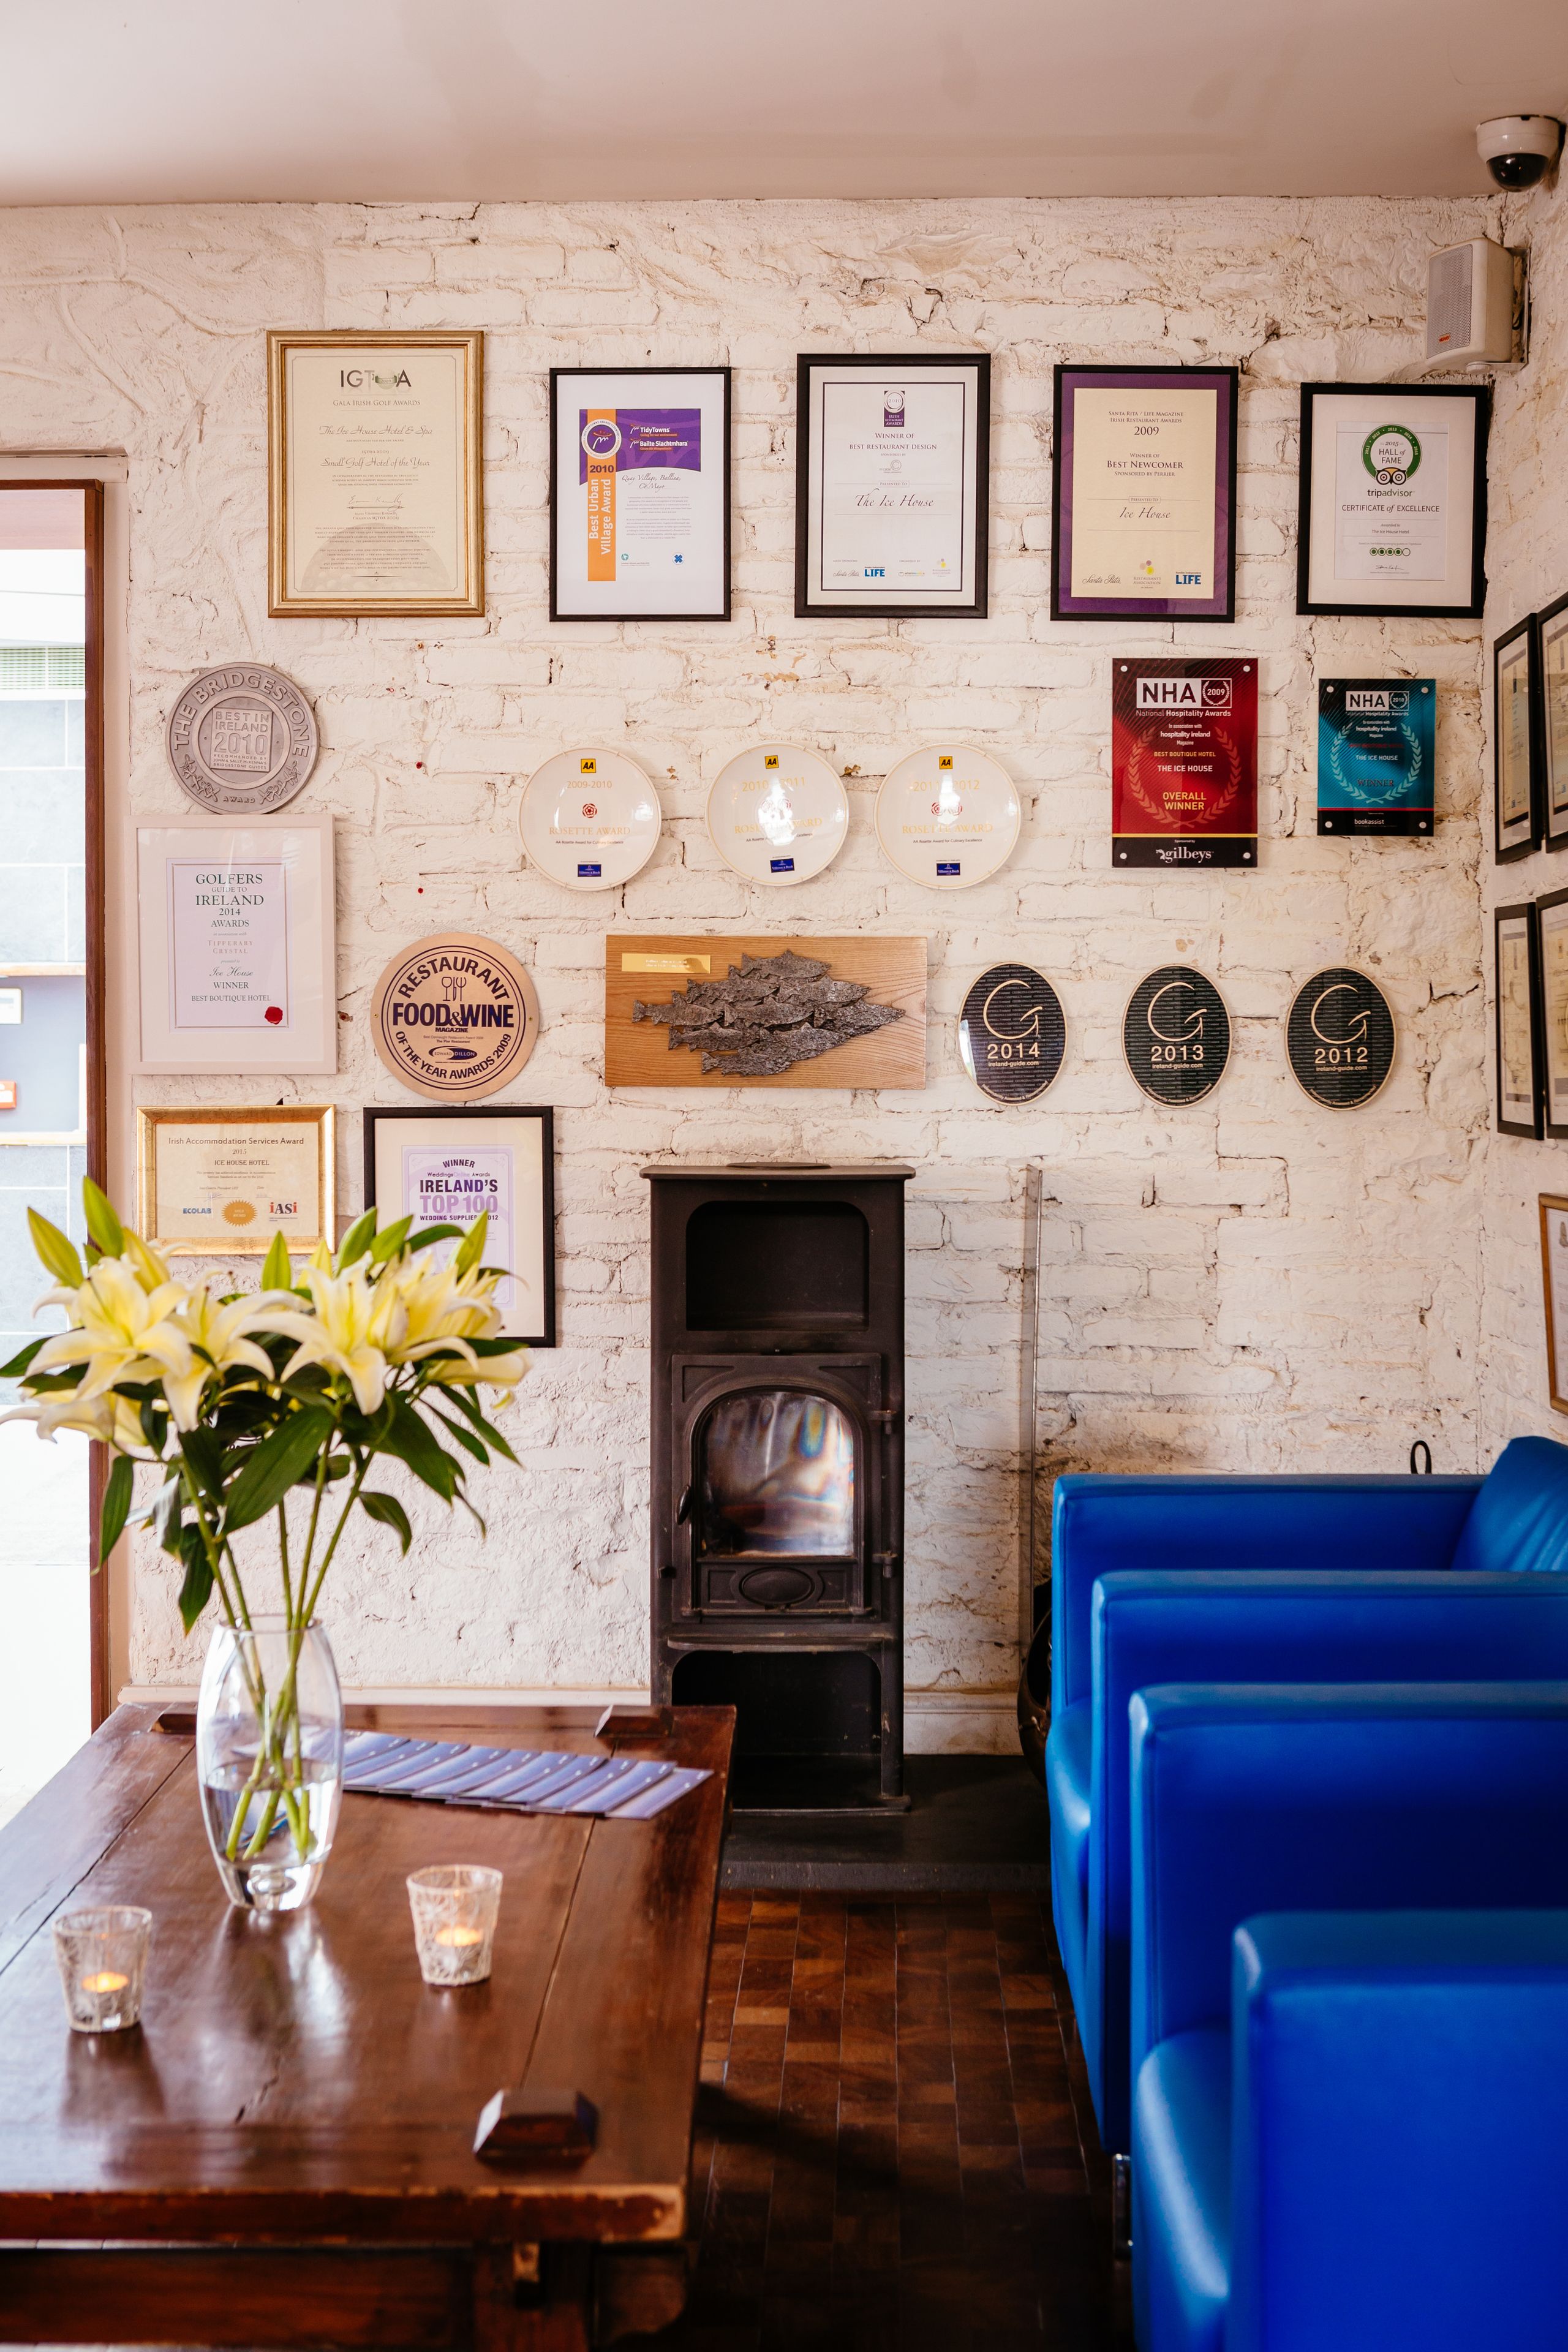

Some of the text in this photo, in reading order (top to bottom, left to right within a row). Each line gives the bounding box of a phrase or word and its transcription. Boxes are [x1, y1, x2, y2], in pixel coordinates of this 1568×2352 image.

[318, 425, 334, 435] The
[336, 426, 348, 435] Ice
[350, 425, 377, 435] House
[379, 425, 404, 435] Hotel
[415, 425, 432, 437] Spa
[1134, 426, 1159, 435] 2009
[320, 458, 430, 470] Small Golf Hotel of the Year
[855, 489, 933, 507] The Ice House
[1367, 489, 1412, 498] tripadvisor
[589, 479, 598, 540] Best Urban
[1119, 507, 1170, 519] Ice House
[601, 479, 613, 555] Village Award
[1082, 574, 1120, 584] Santa Rita
[1176, 575, 1201, 584] LIFE
[1142, 683, 1196, 703] NHA
[1349, 694, 1385, 707] NHA
[174, 671, 310, 758] THE BRIDGESTONE
[216, 711, 270, 723] BEST IN
[215, 721, 268, 733] IRELAND
[214, 732, 268, 756] 2010
[567, 780, 612, 789] 2009-2010
[1357, 778, 1395, 787] WINNER
[1163, 792, 1207, 801] OVERALL
[1164, 802, 1205, 810] WINNER
[195, 873, 263, 884] GOLFERS
[195, 895, 264, 906] IRELAND
[209, 966, 254, 977] Ice House
[398, 956, 510, 1000] RESTAURANT
[393, 1003, 514, 1028] FOOD&WINE
[395, 1031, 511, 1080] OF THE YEAR AWARDS 2009
[987, 1042, 1040, 1059] 2014
[1151, 1044, 1204, 1061] 2013
[1314, 1047, 1368, 1064] 2012
[442, 1159, 475, 1168] WINNER
[420, 1179, 498, 1193] IRELAND'S
[419, 1194, 498, 1213] TOP 100
